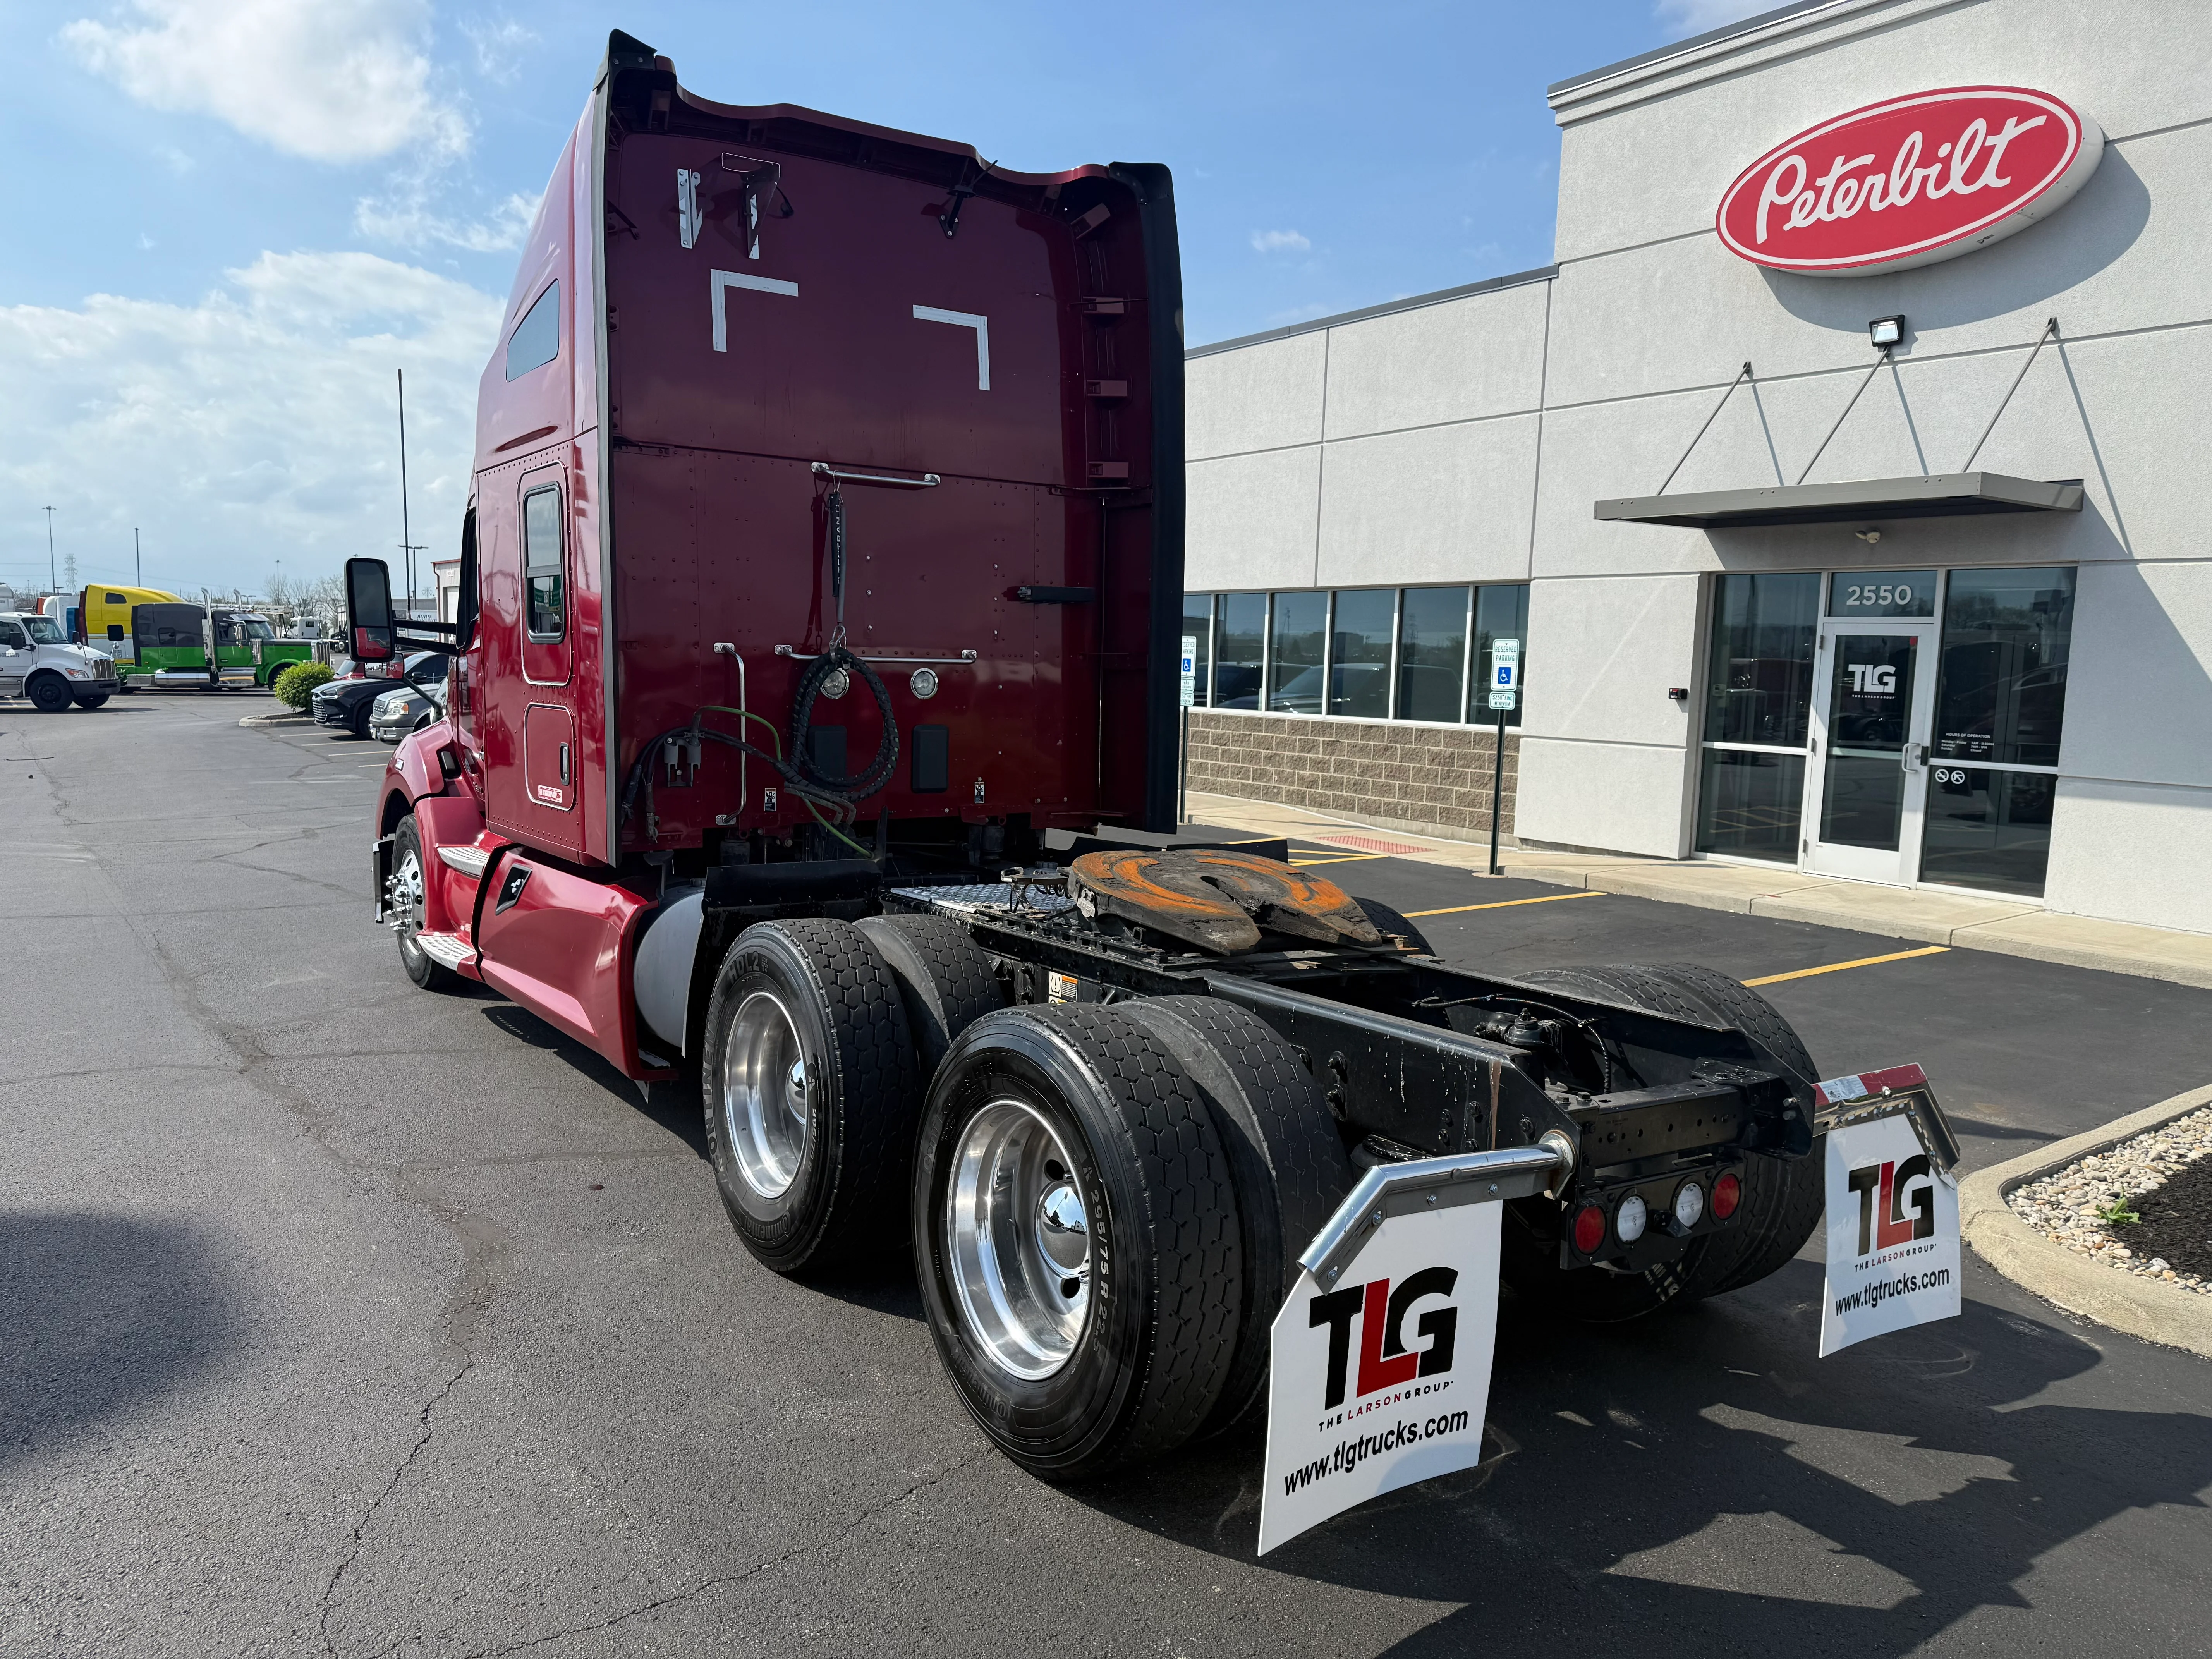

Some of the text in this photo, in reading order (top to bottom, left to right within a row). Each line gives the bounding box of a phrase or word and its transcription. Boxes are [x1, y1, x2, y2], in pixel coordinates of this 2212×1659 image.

[1756, 115, 2047, 244] Peterbilt
[1846, 584, 1912, 606] 2550
[1848, 664, 1896, 693] TLG
[728, 951, 759, 984] HDL2
[1848, 1154, 1935, 1257] TLG
[1090, 1189, 1109, 1353] 295/75 R 22.5
[1855, 1259, 1869, 1273] THE
[1836, 1267, 1949, 1316] www.tlgtrucks.com
[1310, 1267, 1459, 1410] TLG
[1319, 1413, 1342, 1432] THE
[1285, 1410, 1468, 1496] www.tlgtrucks.com
